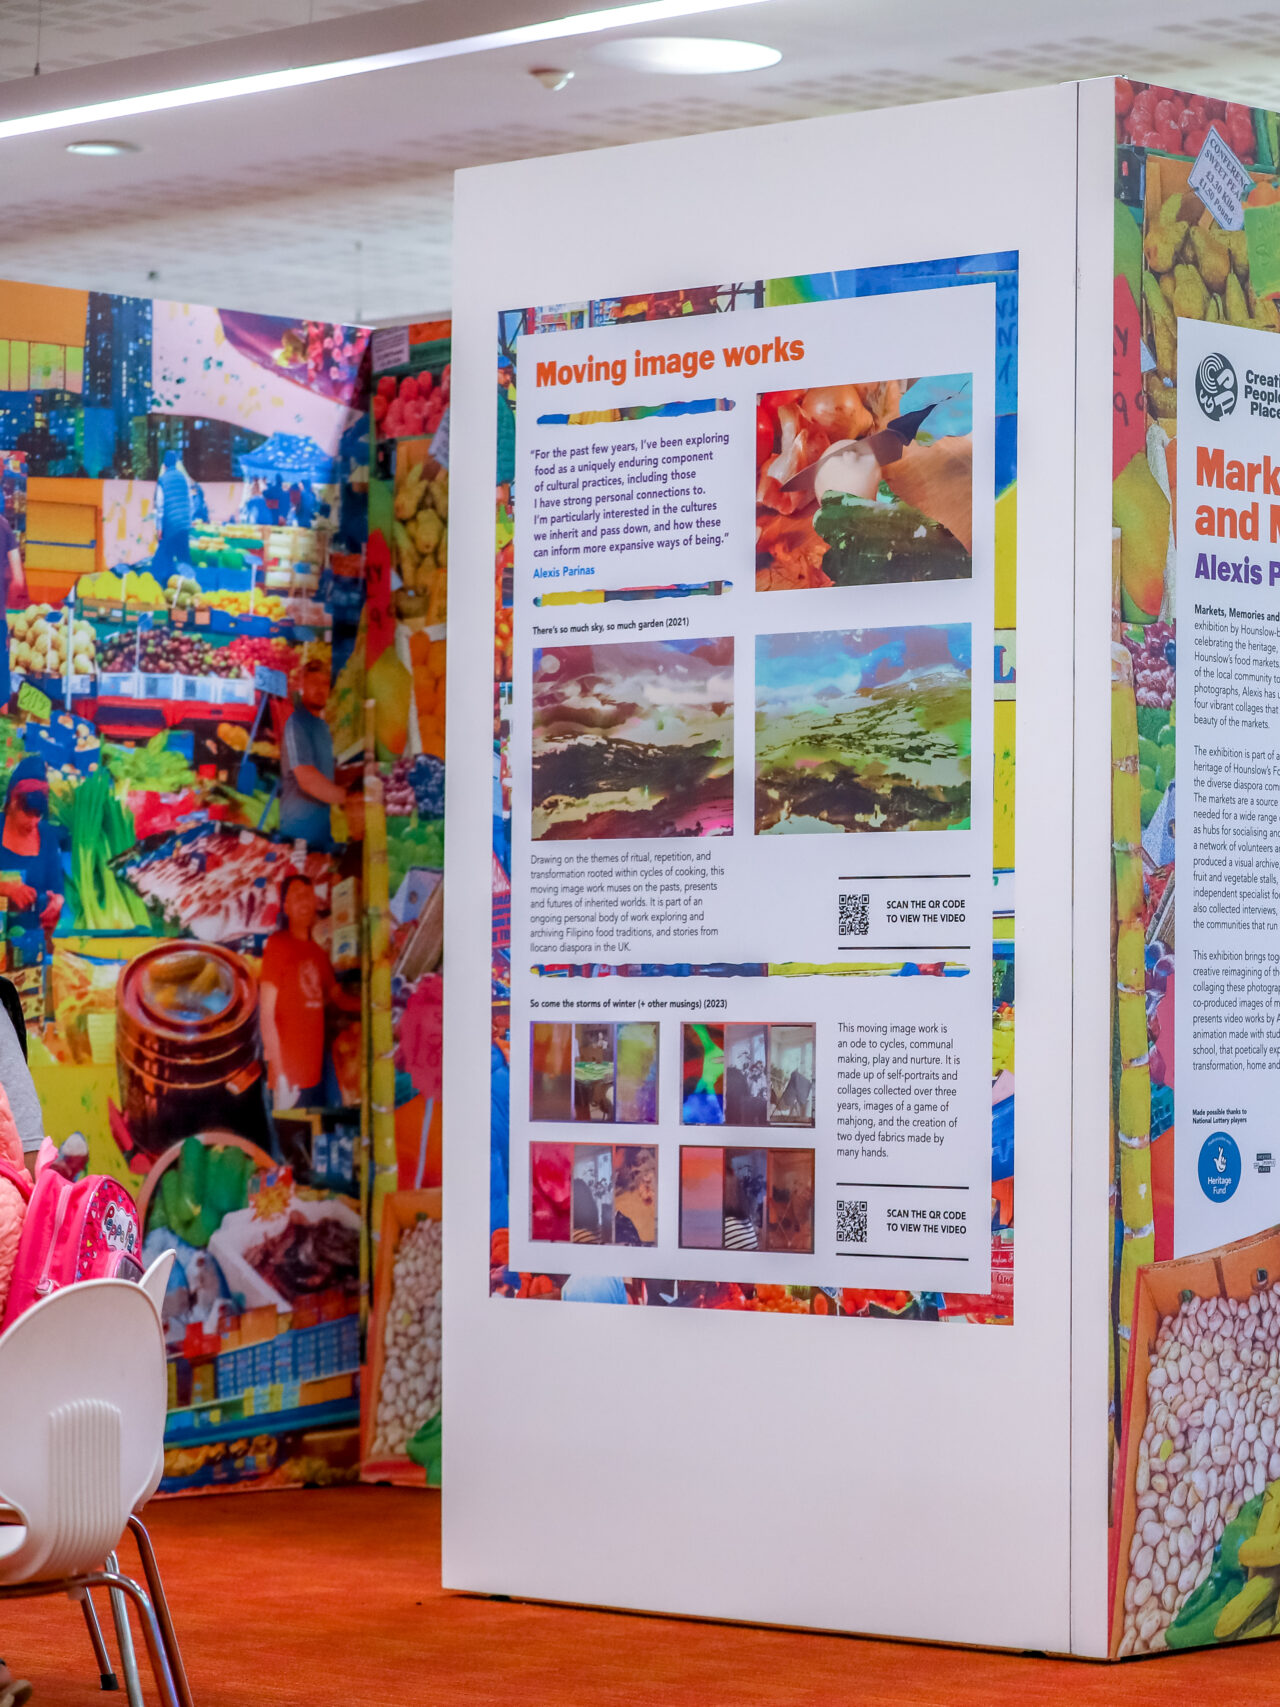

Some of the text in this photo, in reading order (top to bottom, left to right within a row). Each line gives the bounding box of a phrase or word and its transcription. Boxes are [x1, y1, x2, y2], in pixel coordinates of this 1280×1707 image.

[1210, 138, 1248, 192] CONFERENC
[1204, 149, 1242, 202] SWEET PEA
[536, 336, 805, 388] Moving image works
[552, 447, 567, 458] the
[569, 445, 589, 459] past
[591, 443, 609, 455] few
[610, 443, 638, 456] years,
[660, 437, 683, 448] been
[685, 432, 730, 448] exploring
[534, 450, 714, 476] food as a uniquely enduring component
[534, 469, 697, 493] of cultural practices, including those
[533, 517, 721, 541] we inherit and pass down, and how these
[1194, 502, 1260, 542] and
[533, 549, 549, 558] can
[551, 544, 581, 556] inform
[583, 544, 607, 554] more
[609, 539, 655, 554] expansive
[656, 539, 681, 551] ways
[682, 534, 693, 546] of
[533, 565, 595, 579] Alexis Parinas
[1194, 552, 1263, 586] Alexis
[1194, 603, 1227, 618] Markets,
[1228, 607, 1265, 621] Memories
[1266, 611, 1280, 622] and
[569, 623, 590, 633] much
[591, 622, 605, 634] sky,
[616, 620, 637, 630] much
[638, 618, 664, 631] garden
[665, 617, 690, 628] (2021)
[530, 850, 712, 867] Drawing on the themes of ritual, repetition, and
[886, 899, 966, 909] SCAN THE QR CODE
[886, 913, 966, 923] TO VIEW THE VIDEO
[530, 999, 540, 1008] So
[562, 999, 575, 1008] the
[576, 1000, 601, 1008] storms
[602, 998, 611, 1008] of
[612, 999, 637, 1008] winter
[647, 998, 668, 1008] other
[669, 999, 702, 1011] musings)
[703, 999, 728, 1009] (2023)
[837, 1022, 948, 1036] This moving image work is
[1192, 1108, 1206, 1116] Made
[1206, 1108, 1226, 1117] possible
[1212, 1117, 1230, 1125] Lottery
[1230, 1116, 1247, 1125] players
[1207, 1176, 1232, 1187] Heritage
[1212, 1186, 1227, 1195] Fund
[886, 1208, 967, 1221] SCAN THE QR CODE
[886, 1222, 967, 1235] TO VIEW THE VIDEO
